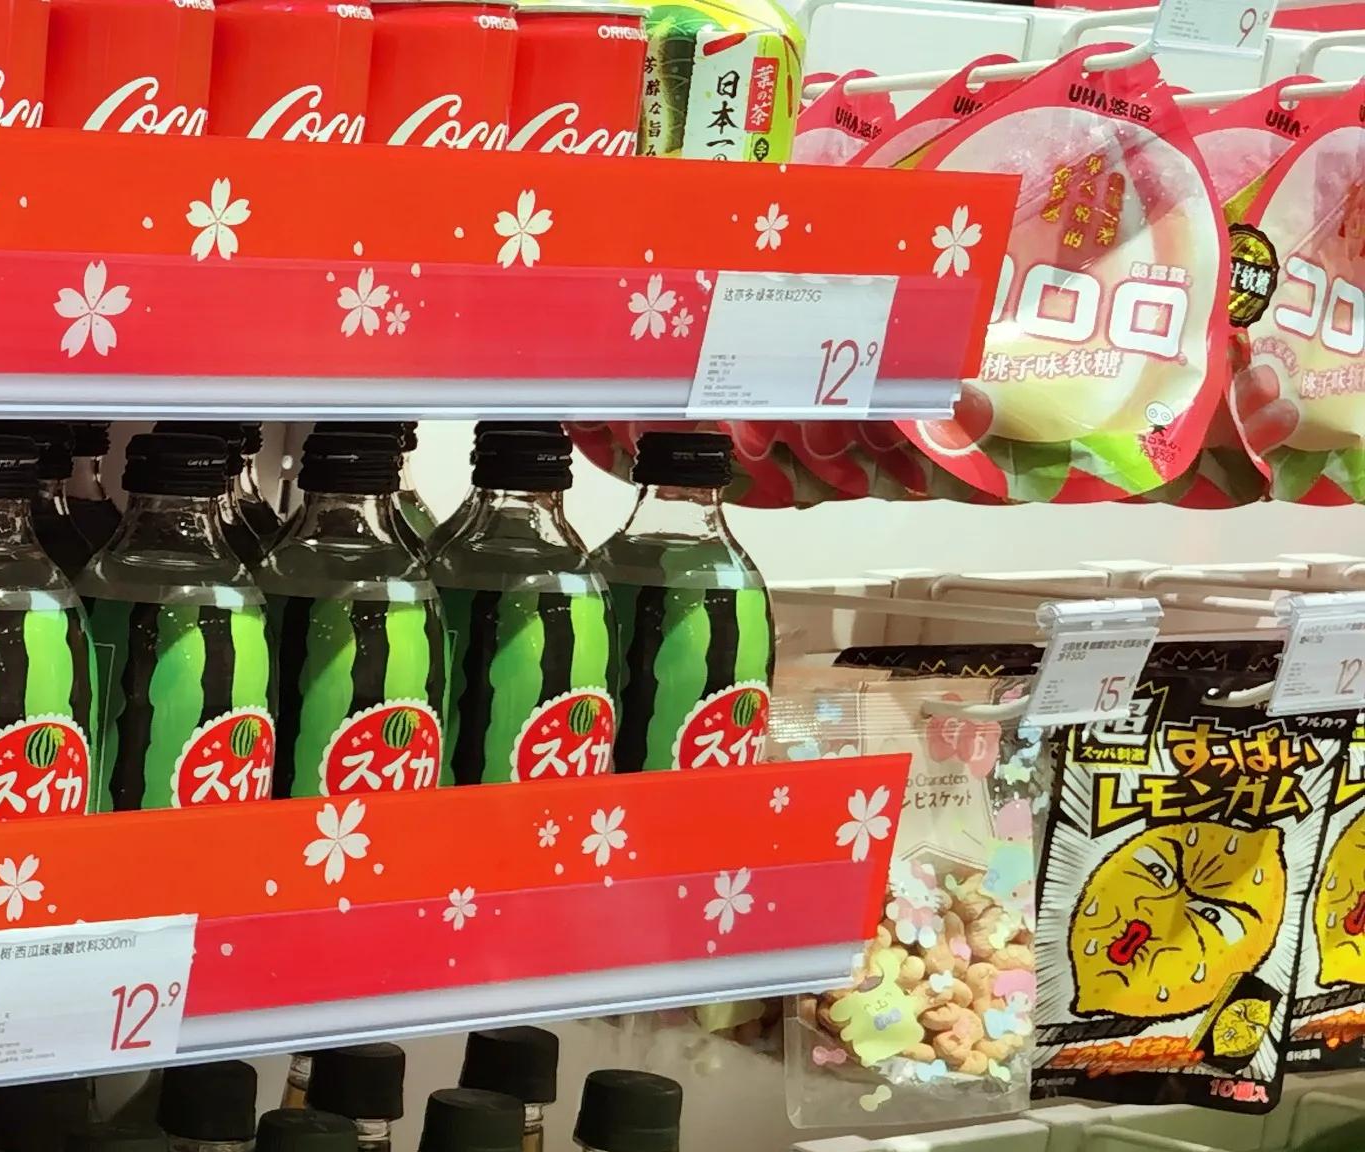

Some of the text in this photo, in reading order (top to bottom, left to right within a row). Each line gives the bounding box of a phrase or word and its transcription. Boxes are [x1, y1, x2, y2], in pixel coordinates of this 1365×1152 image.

[1069, 83, 1153, 123] UHA悠哈
[813, 339, 879, 406] 12.9
[983, 350, 1121, 382] 桃子味软糖
[1296, 715, 1348, 730] マルカワ
[531, 737, 613, 780] スイカ
[1167, 723, 1319, 777] すっぱい
[336, 751, 437, 794] スイカ
[1094, 772, 1313, 828] レモンガム
[111, 981, 182, 1052] 12.9
